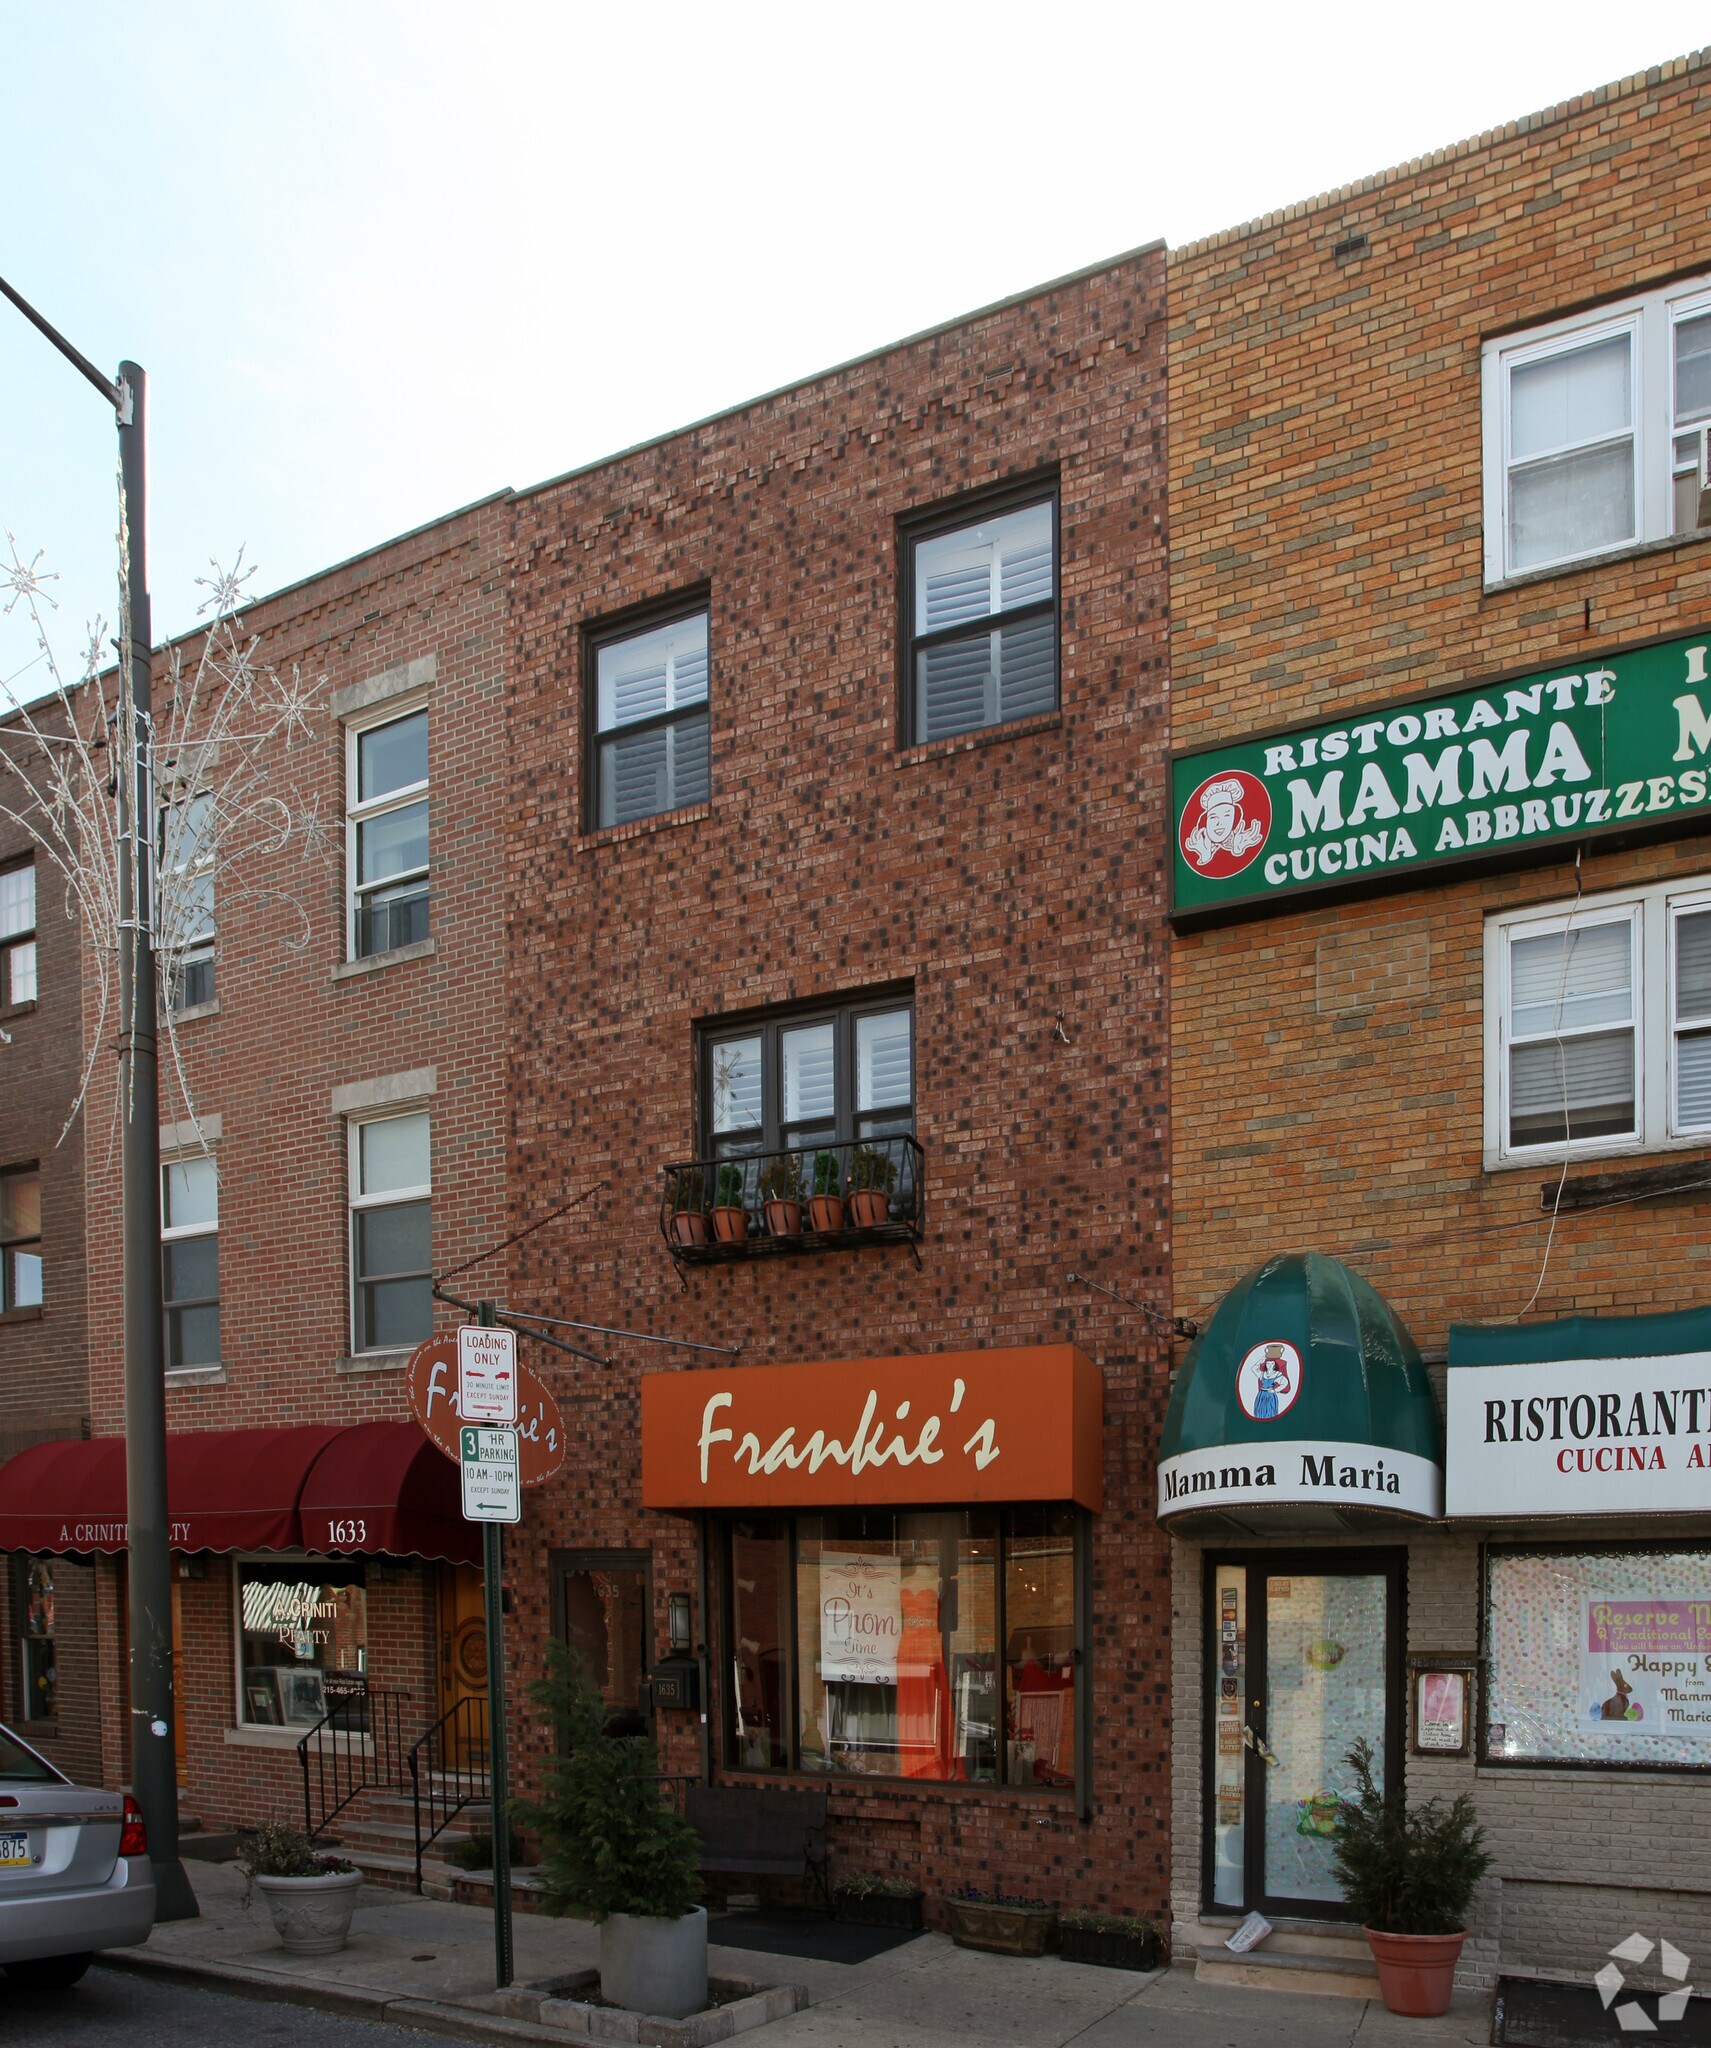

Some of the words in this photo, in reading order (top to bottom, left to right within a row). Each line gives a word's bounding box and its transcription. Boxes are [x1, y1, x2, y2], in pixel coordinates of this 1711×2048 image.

[1263, 670, 1617, 776] RISTORANTE
[1286, 721, 1592, 840] MAMMA
[1263, 826, 1418, 885] CUCINA
[1434, 767, 1711, 852] ABBRUZZES
[466, 1336, 507, 1351] LOADING
[474, 1352, 500, 1365] ONLY
[466, 1391, 487, 1399] EXCEPT
[489, 1393, 510, 1401] SUNDAY
[475, 1382, 494, 1390] MINUTE
[425, 1360, 559, 1453] Frie's
[1483, 1388, 1711, 1443] RISTORANT
[697, 1378, 1001, 1484] Frankie's
[465, 1432, 476, 1456] 3
[490, 1433, 505, 1446] HR
[480, 1447, 515, 1461] PARKING
[1556, 1445, 1667, 1473] CUCINA
[1163, 1463, 1277, 1502] Mamma
[1299, 1454, 1401, 1495] Maria
[470, 1486, 489, 1494] EXCEPT
[490, 1487, 510, 1495] SUNDAY
[328, 1519, 367, 1543] 1633
[845, 1582, 874, 1598] It's
[824, 1597, 899, 1636] Prom
[1592, 1604, 1680, 1626] Reserve
[1612, 1627, 1692, 1640] Traditional
[844, 1637, 879, 1655] Time
[1610, 1641, 1628, 1652] You
[1631, 1642, 1647, 1650] will
[1649, 1642, 1669, 1651] have
[1627, 1654, 1697, 1677] Happy
[658, 1683, 676, 1696] 1635
[1685, 1678, 1705, 1688] from
[0, 1839, 26, 1859] 875
